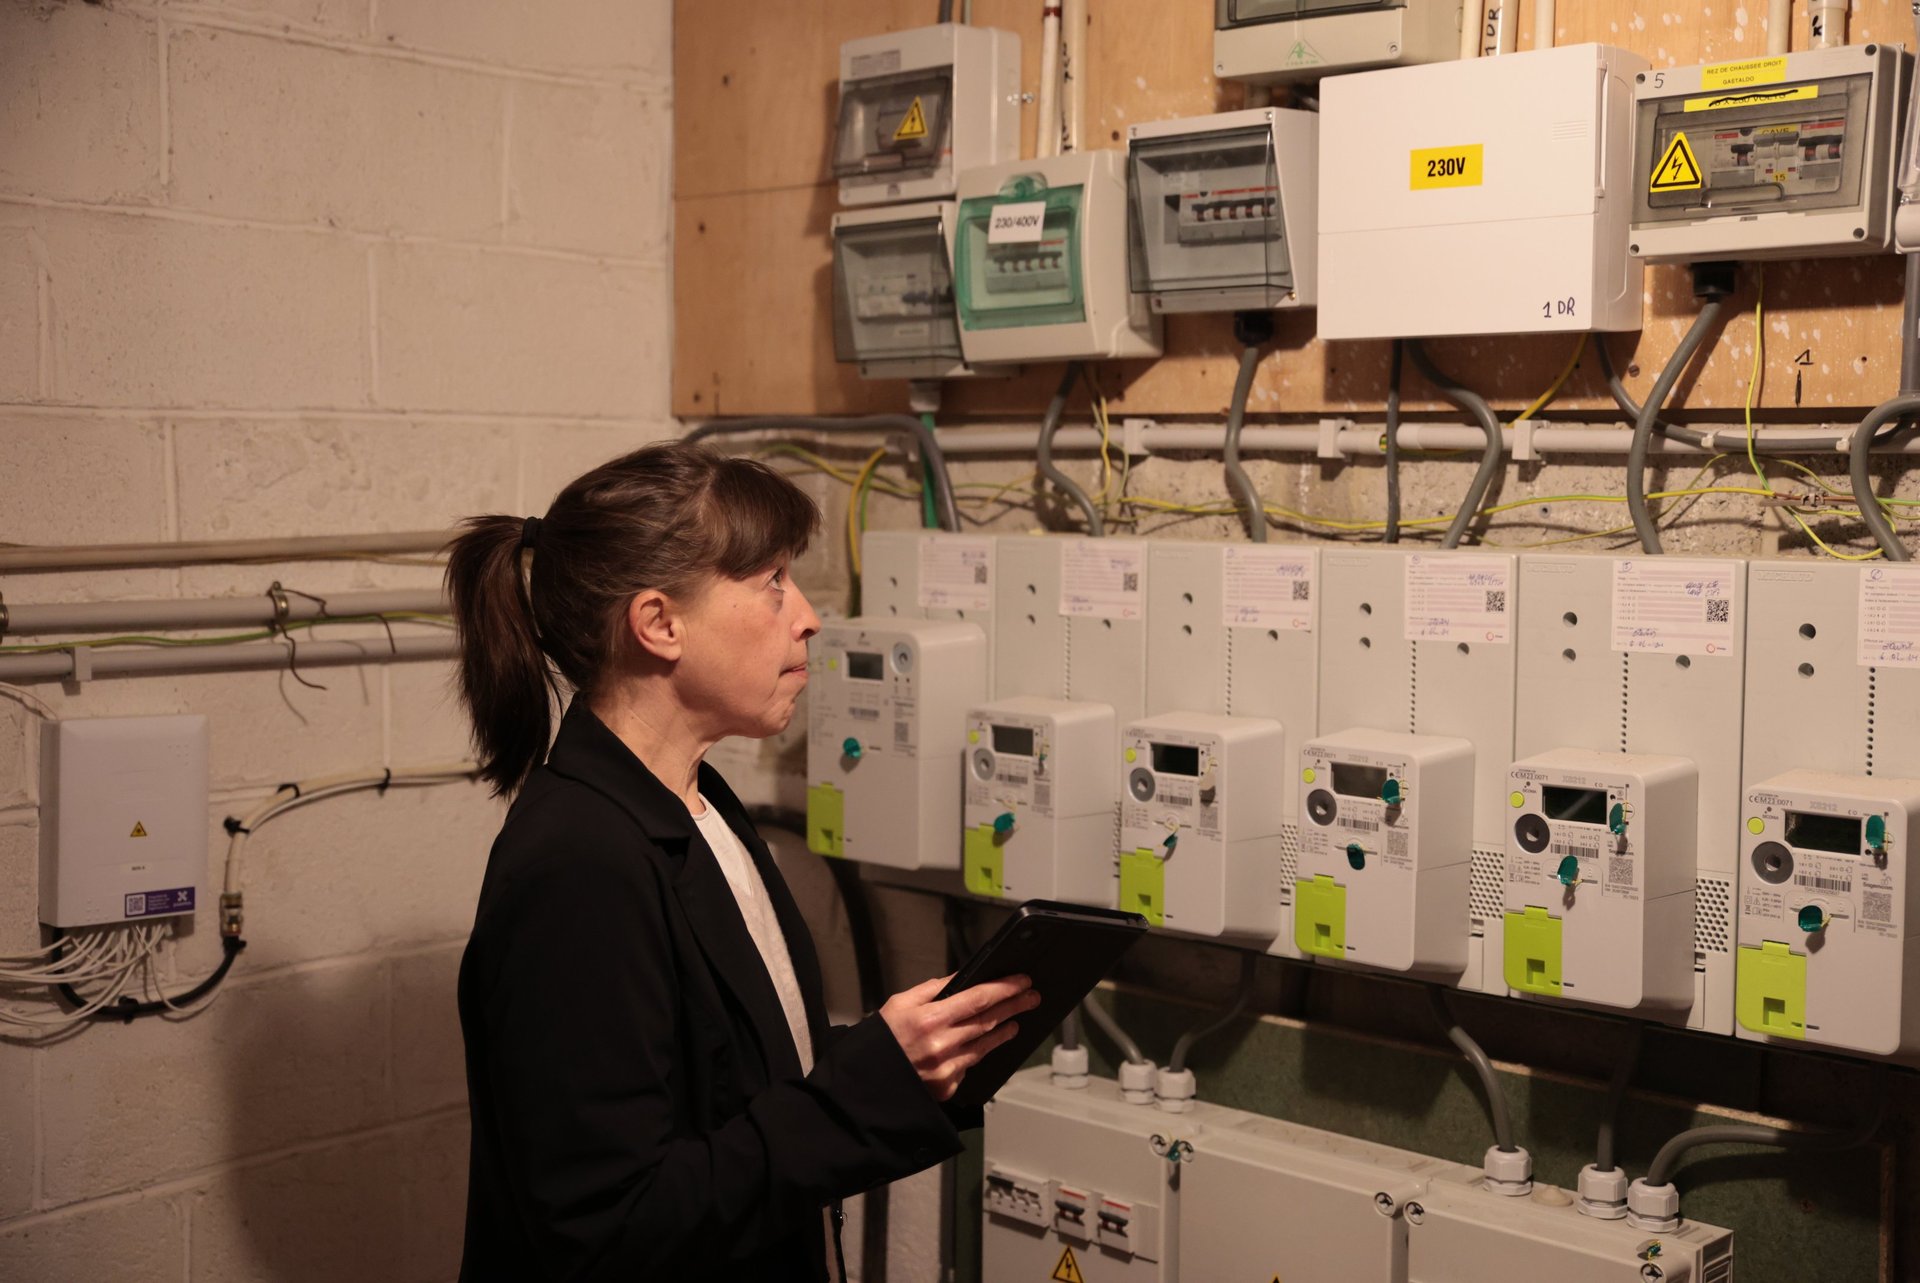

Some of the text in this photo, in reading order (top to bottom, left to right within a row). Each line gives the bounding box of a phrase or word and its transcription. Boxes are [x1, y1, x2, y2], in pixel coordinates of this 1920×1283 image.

[1730, 62, 1762, 72] CHAUSSEE
[1763, 60, 1782, 68] DROIT
[1654, 73, 1665, 88] 5
[1722, 76, 1755, 85] GASTALDO
[1427, 157, 1466, 178] 230V
[995, 215, 1040, 229] 230/400V
[1542, 296, 1575, 318] 1 DR
